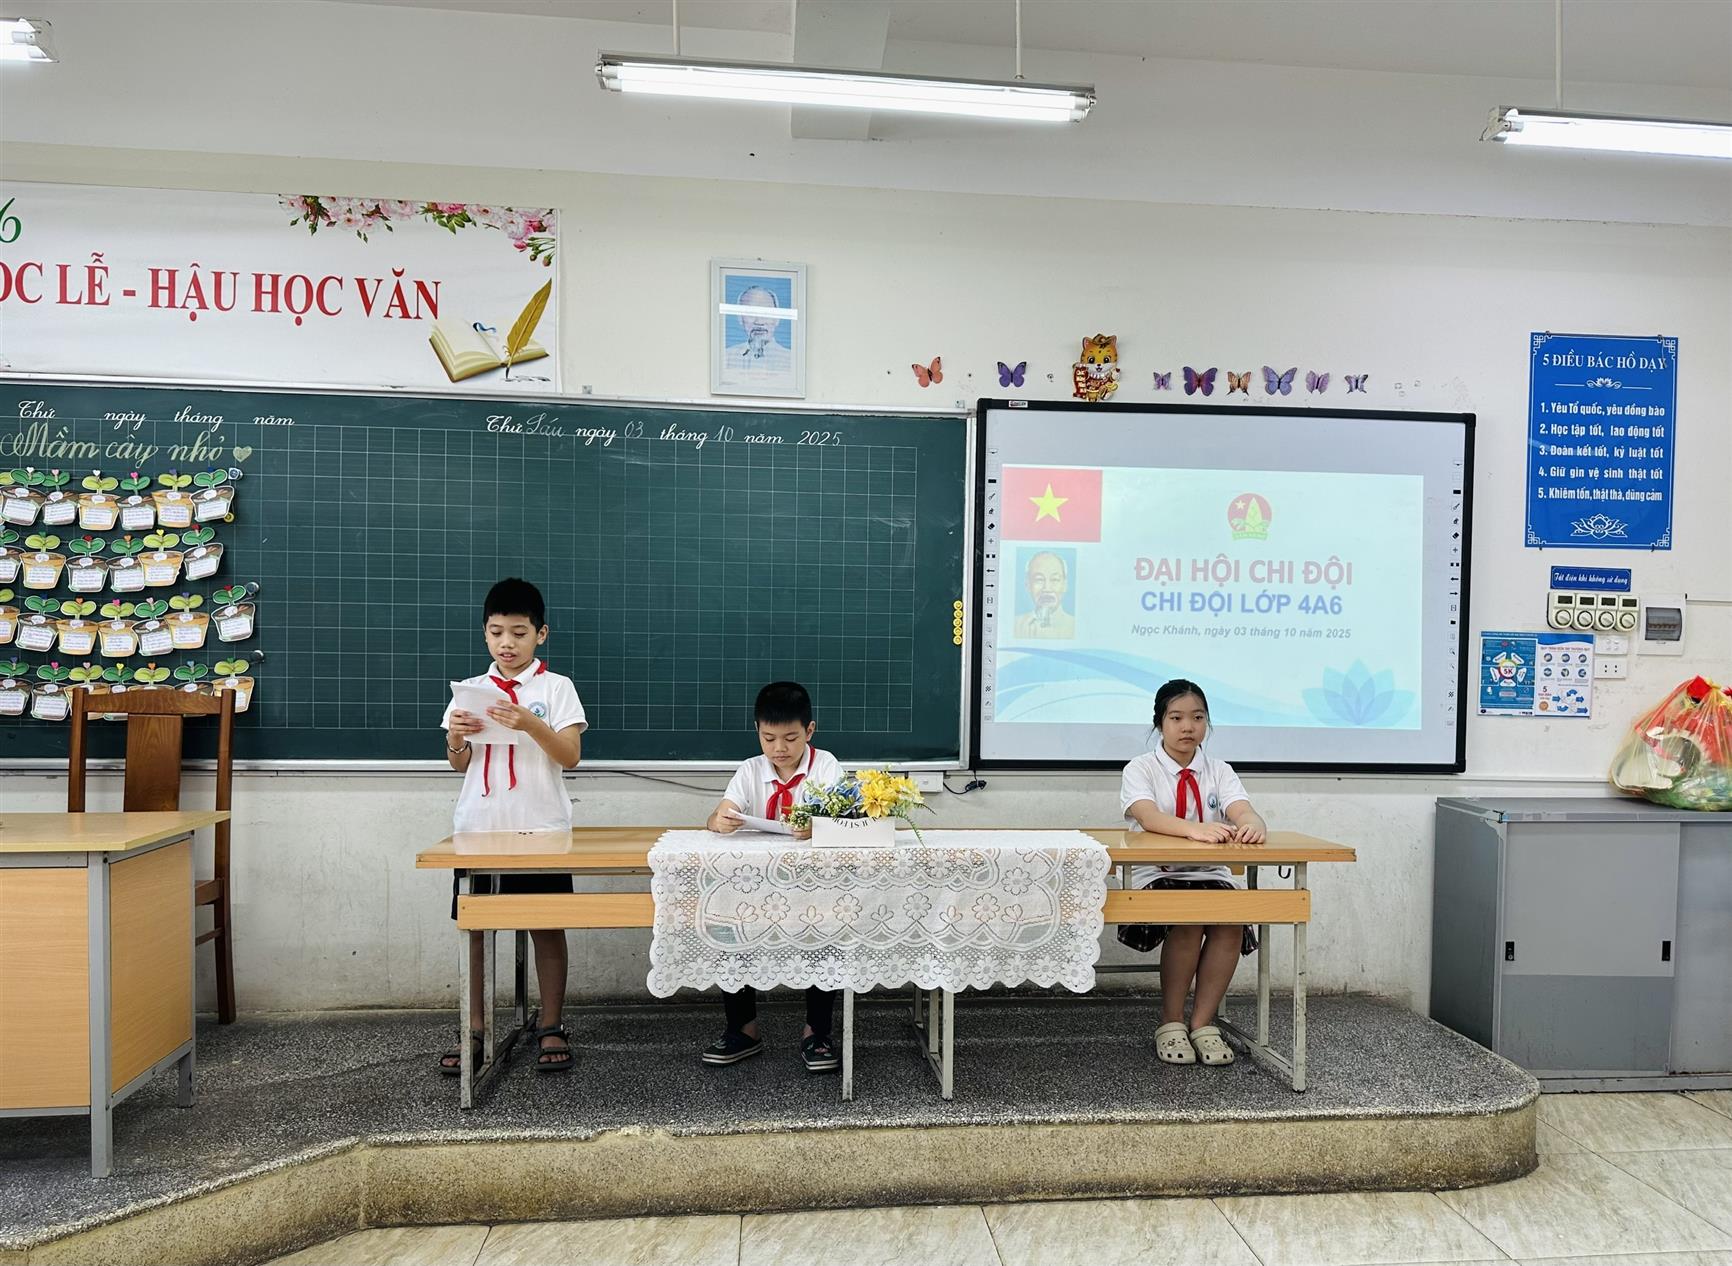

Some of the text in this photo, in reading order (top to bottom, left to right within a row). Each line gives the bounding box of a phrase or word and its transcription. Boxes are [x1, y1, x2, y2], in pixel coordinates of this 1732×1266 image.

[56, 252, 110, 306] LỄ
[147, 263, 240, 322] HẬU
[251, 272, 344, 326] HỌC
[354, 267, 441, 320] VĂN
[1543, 348, 1667, 373] 5 ĐIỀU BÁC HỒ DẠY
[18, 400, 295, 432] Thứ ngày tháng năm
[1541, 401, 1665, 417] 1. Yêu Tổ quốc, yêu đồng bào
[0, 421, 100, 459] Mầm
[167, 430, 225, 463] nhỏ
[486, 415, 523, 433] Thứ
[575, 426, 617, 447] ngày
[624, 420, 644, 439] 03
[659, 423, 708, 450] tháng
[714, 425, 734, 442] 10
[744, 432, 784, 444] năm
[797, 430, 843, 446] 2025
[1540, 423, 1665, 439] 2. Học tập tốt, lao động tốt
[1539, 445, 1548, 455] 3.
[1550, 445, 1573, 456] Đoàn
[1577, 444, 1591, 456] kết
[1594, 445, 1609, 458] tốt,
[1629, 447, 1646, 460] luật
[1650, 447, 1664, 458] tốt
[1538, 466, 1547, 477] 4.
[1550, 466, 1566, 477] Giữ
[1588, 467, 1600, 480] vệ
[1603, 468, 1623, 478] sinh
[1628, 468, 1647, 481] thật
[1650, 468, 1663, 480] tốt
[1538, 488, 1547, 499] 5.
[1549, 488, 1575, 499] Khiêm
[1576, 486, 1592, 500] tốn,
[1593, 488, 1608, 502] thật
[1646, 488, 1662, 501] cảm
[1134, 553, 1353, 590] ĐẠI HỘI CHI ĐỘI
[1141, 589, 1343, 617] CHI ĐỘI LỚP 4A6
[1131, 623, 1352, 639] Ngọc Khánh, ngày 03 tháng 10 năm 2025
